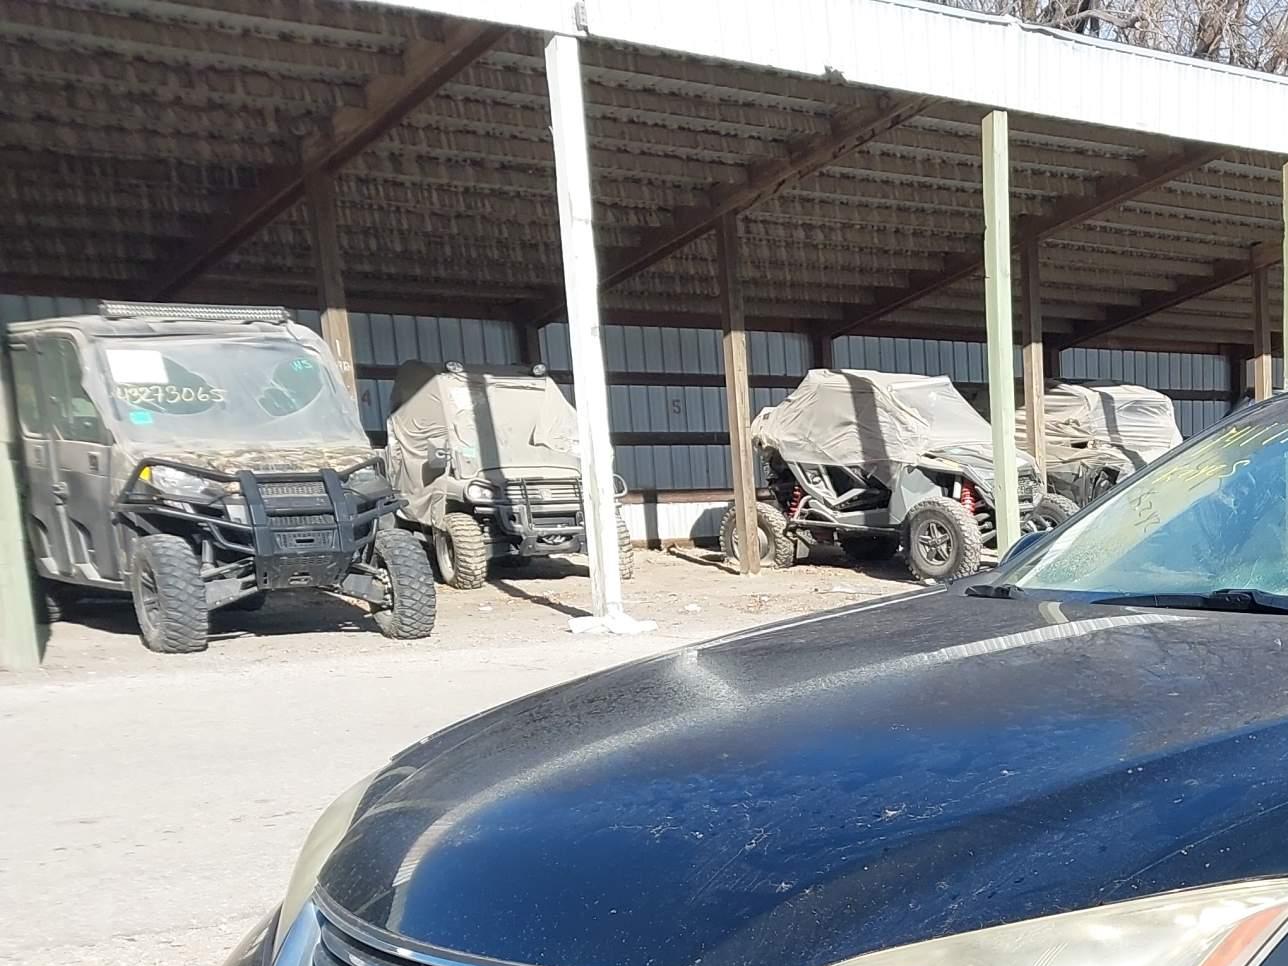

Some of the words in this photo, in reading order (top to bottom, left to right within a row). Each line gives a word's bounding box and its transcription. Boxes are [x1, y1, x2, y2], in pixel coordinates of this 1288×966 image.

[116, 384, 228, 404] 43273065
[361, 389, 372, 407] 4
[671, 399, 682, 415] 5
